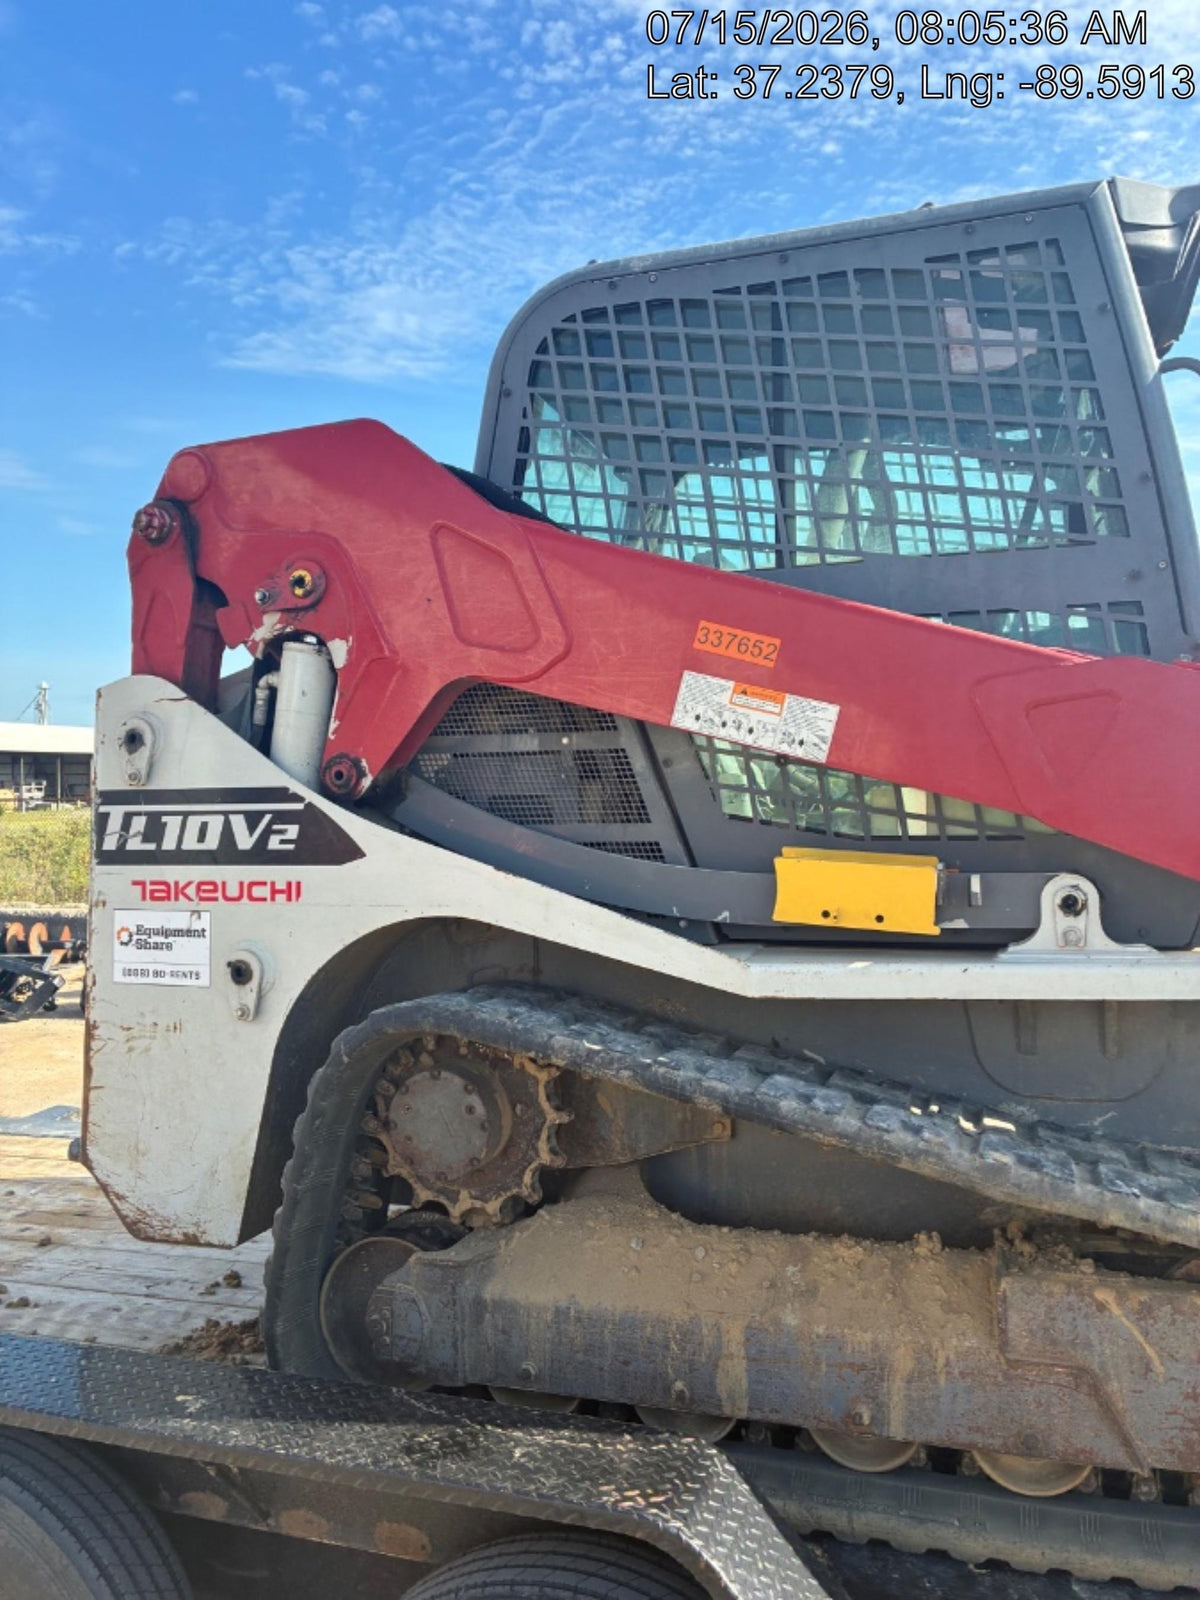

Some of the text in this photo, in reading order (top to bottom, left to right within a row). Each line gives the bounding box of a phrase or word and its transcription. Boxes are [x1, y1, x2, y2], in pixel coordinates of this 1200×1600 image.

[697, 626, 778, 662] 337652
[98, 803, 304, 851] TL10V2
[135, 924, 207, 939] Equipment
[135, 938, 173, 951] Share
